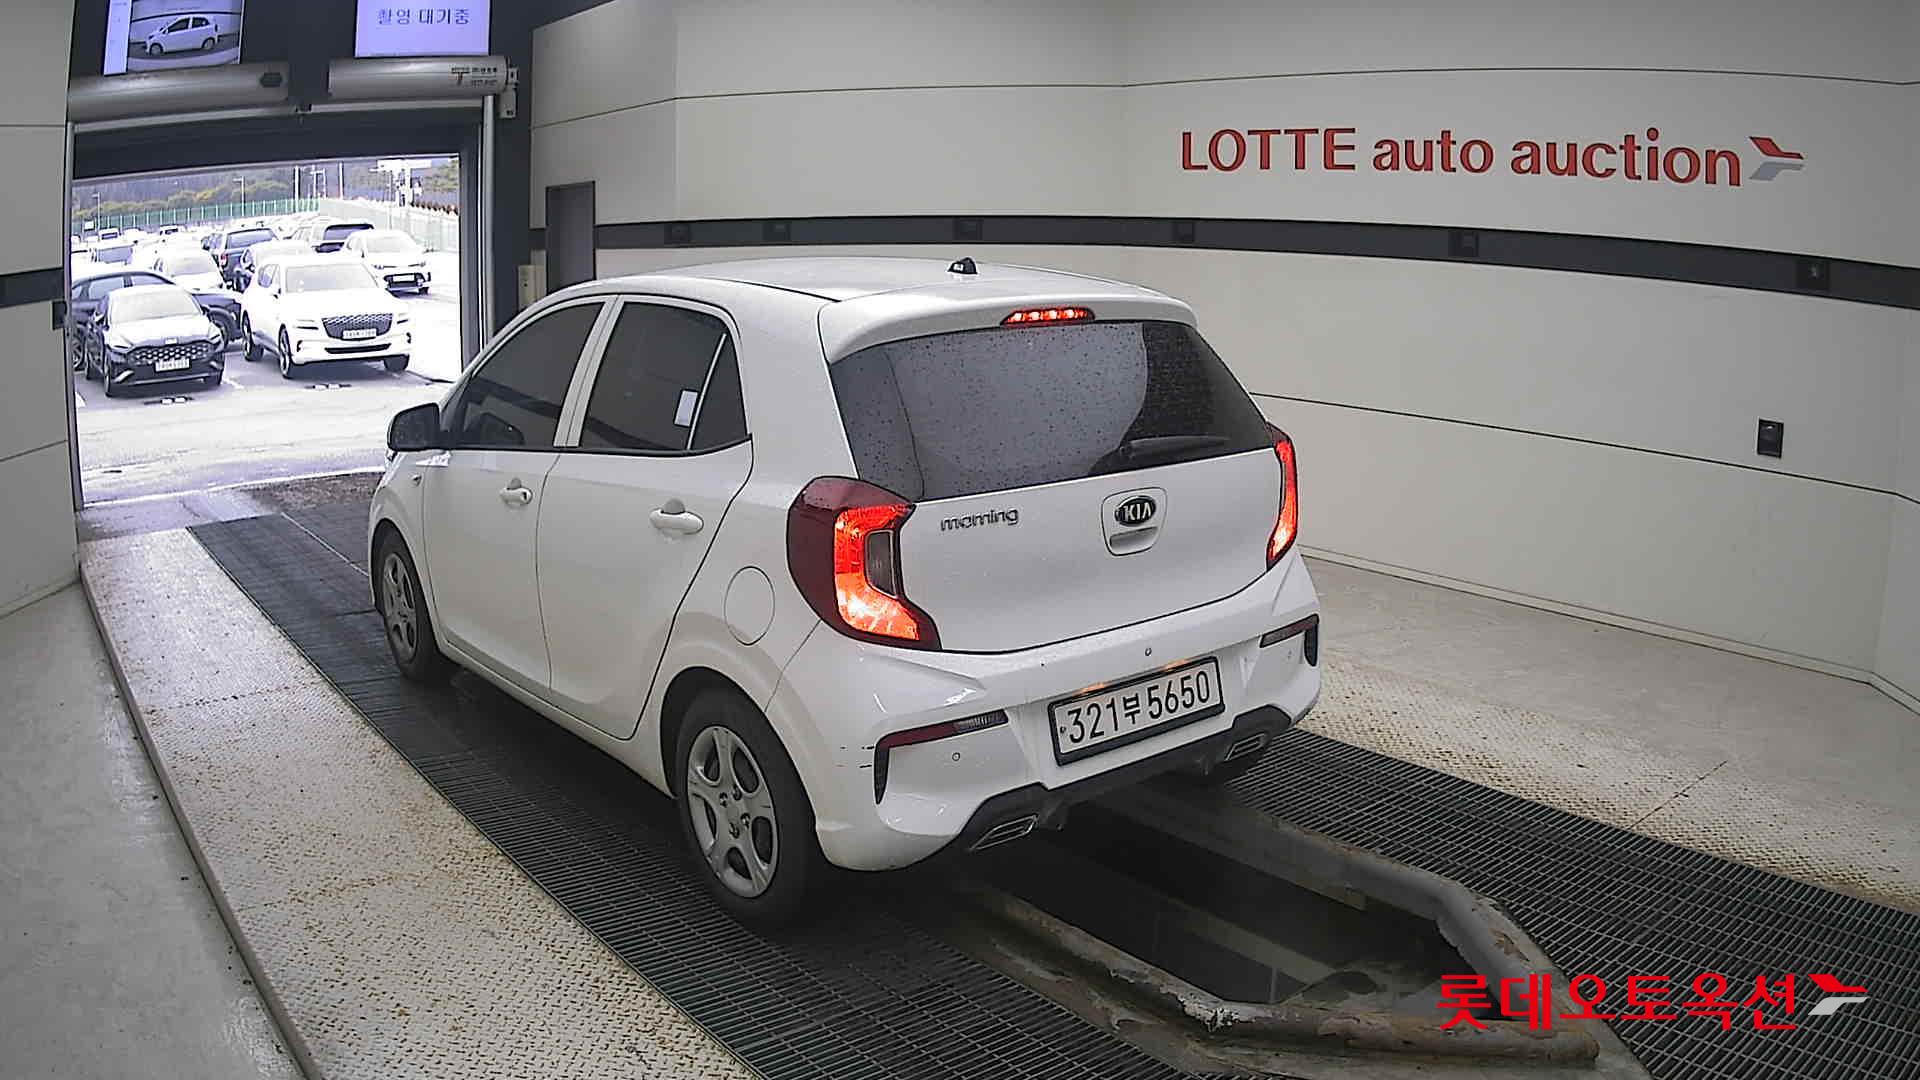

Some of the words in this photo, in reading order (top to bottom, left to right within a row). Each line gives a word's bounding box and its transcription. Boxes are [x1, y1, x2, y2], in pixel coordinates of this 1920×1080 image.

[419, 8, 470, 25] 대기중
[1182, 127, 1357, 171] LOTTE
[1372, 130, 1495, 172] auto
[1511, 127, 1742, 186] auction
[940, 508, 1019, 532] morning
[1122, 500, 1153, 523] KIA
